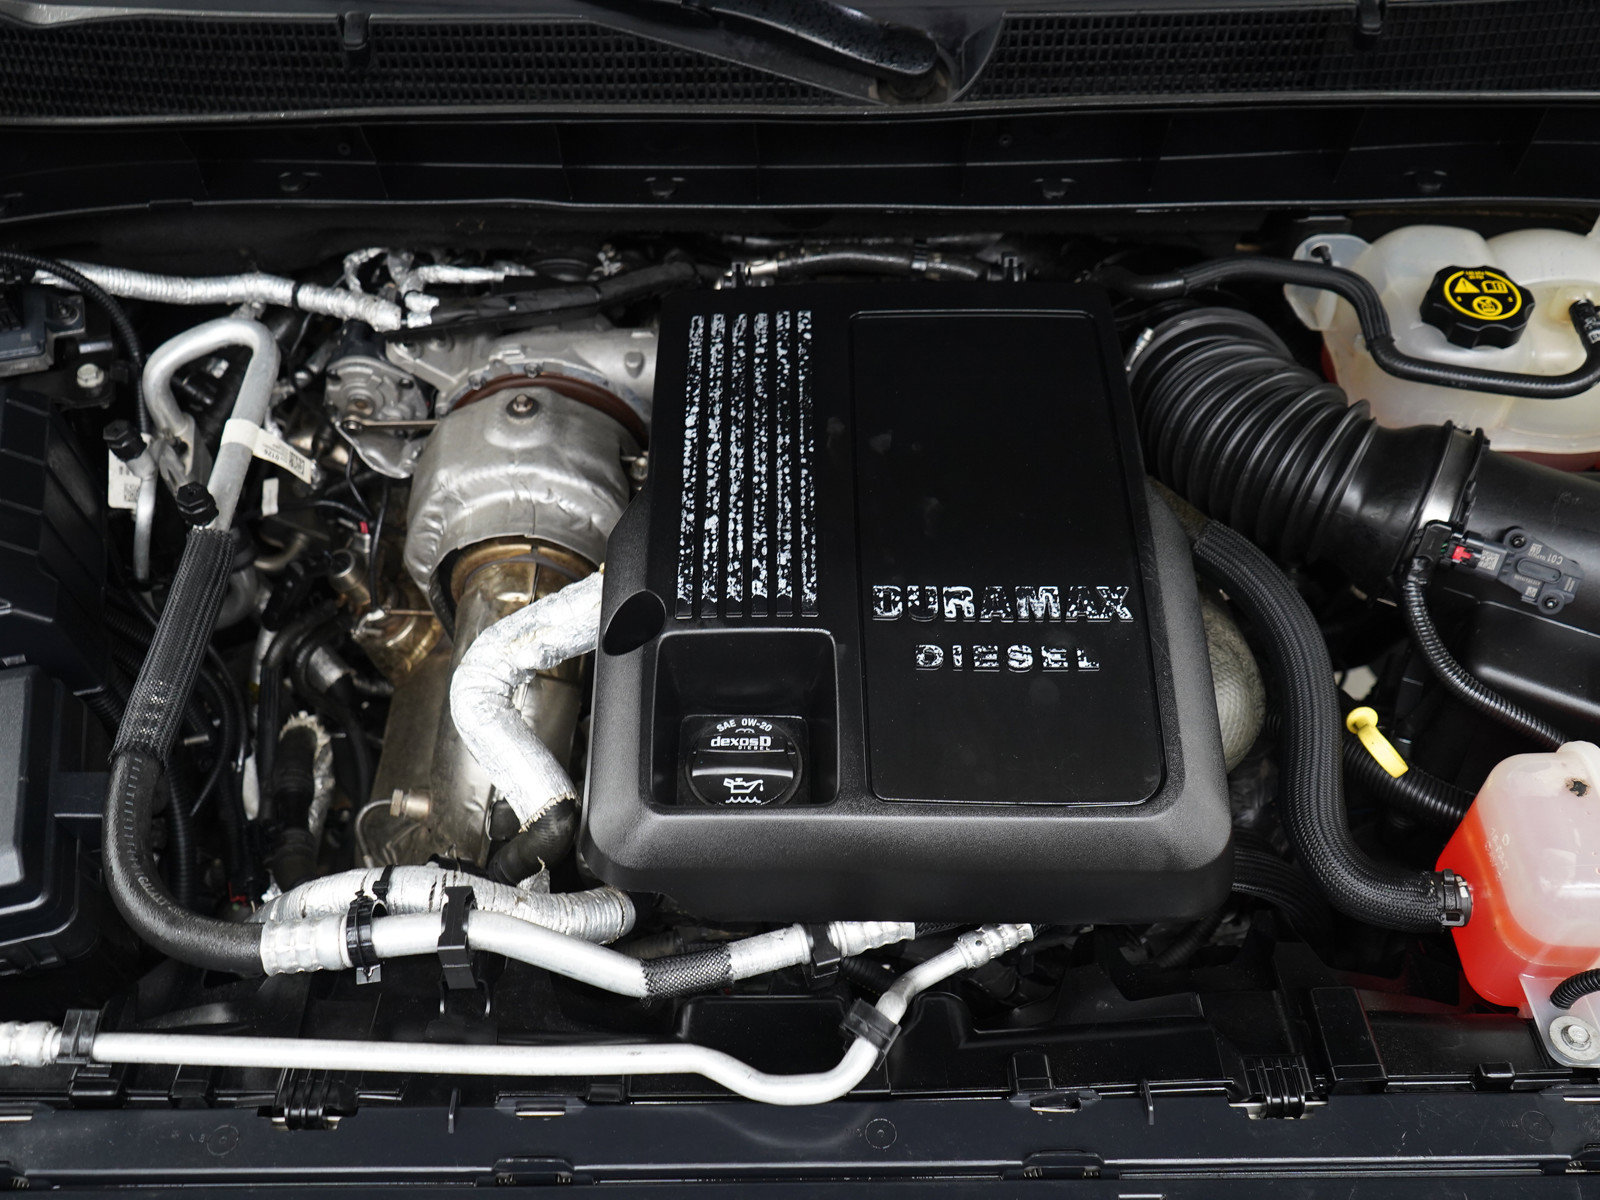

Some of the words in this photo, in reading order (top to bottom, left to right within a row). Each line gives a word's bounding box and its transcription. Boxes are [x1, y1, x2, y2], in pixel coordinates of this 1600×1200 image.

[872, 585, 1134, 622] DURAMAX
[915, 644, 1100, 673] DIESEL
[717, 720, 735, 731] SAE
[741, 718, 772, 732] 0W-20
